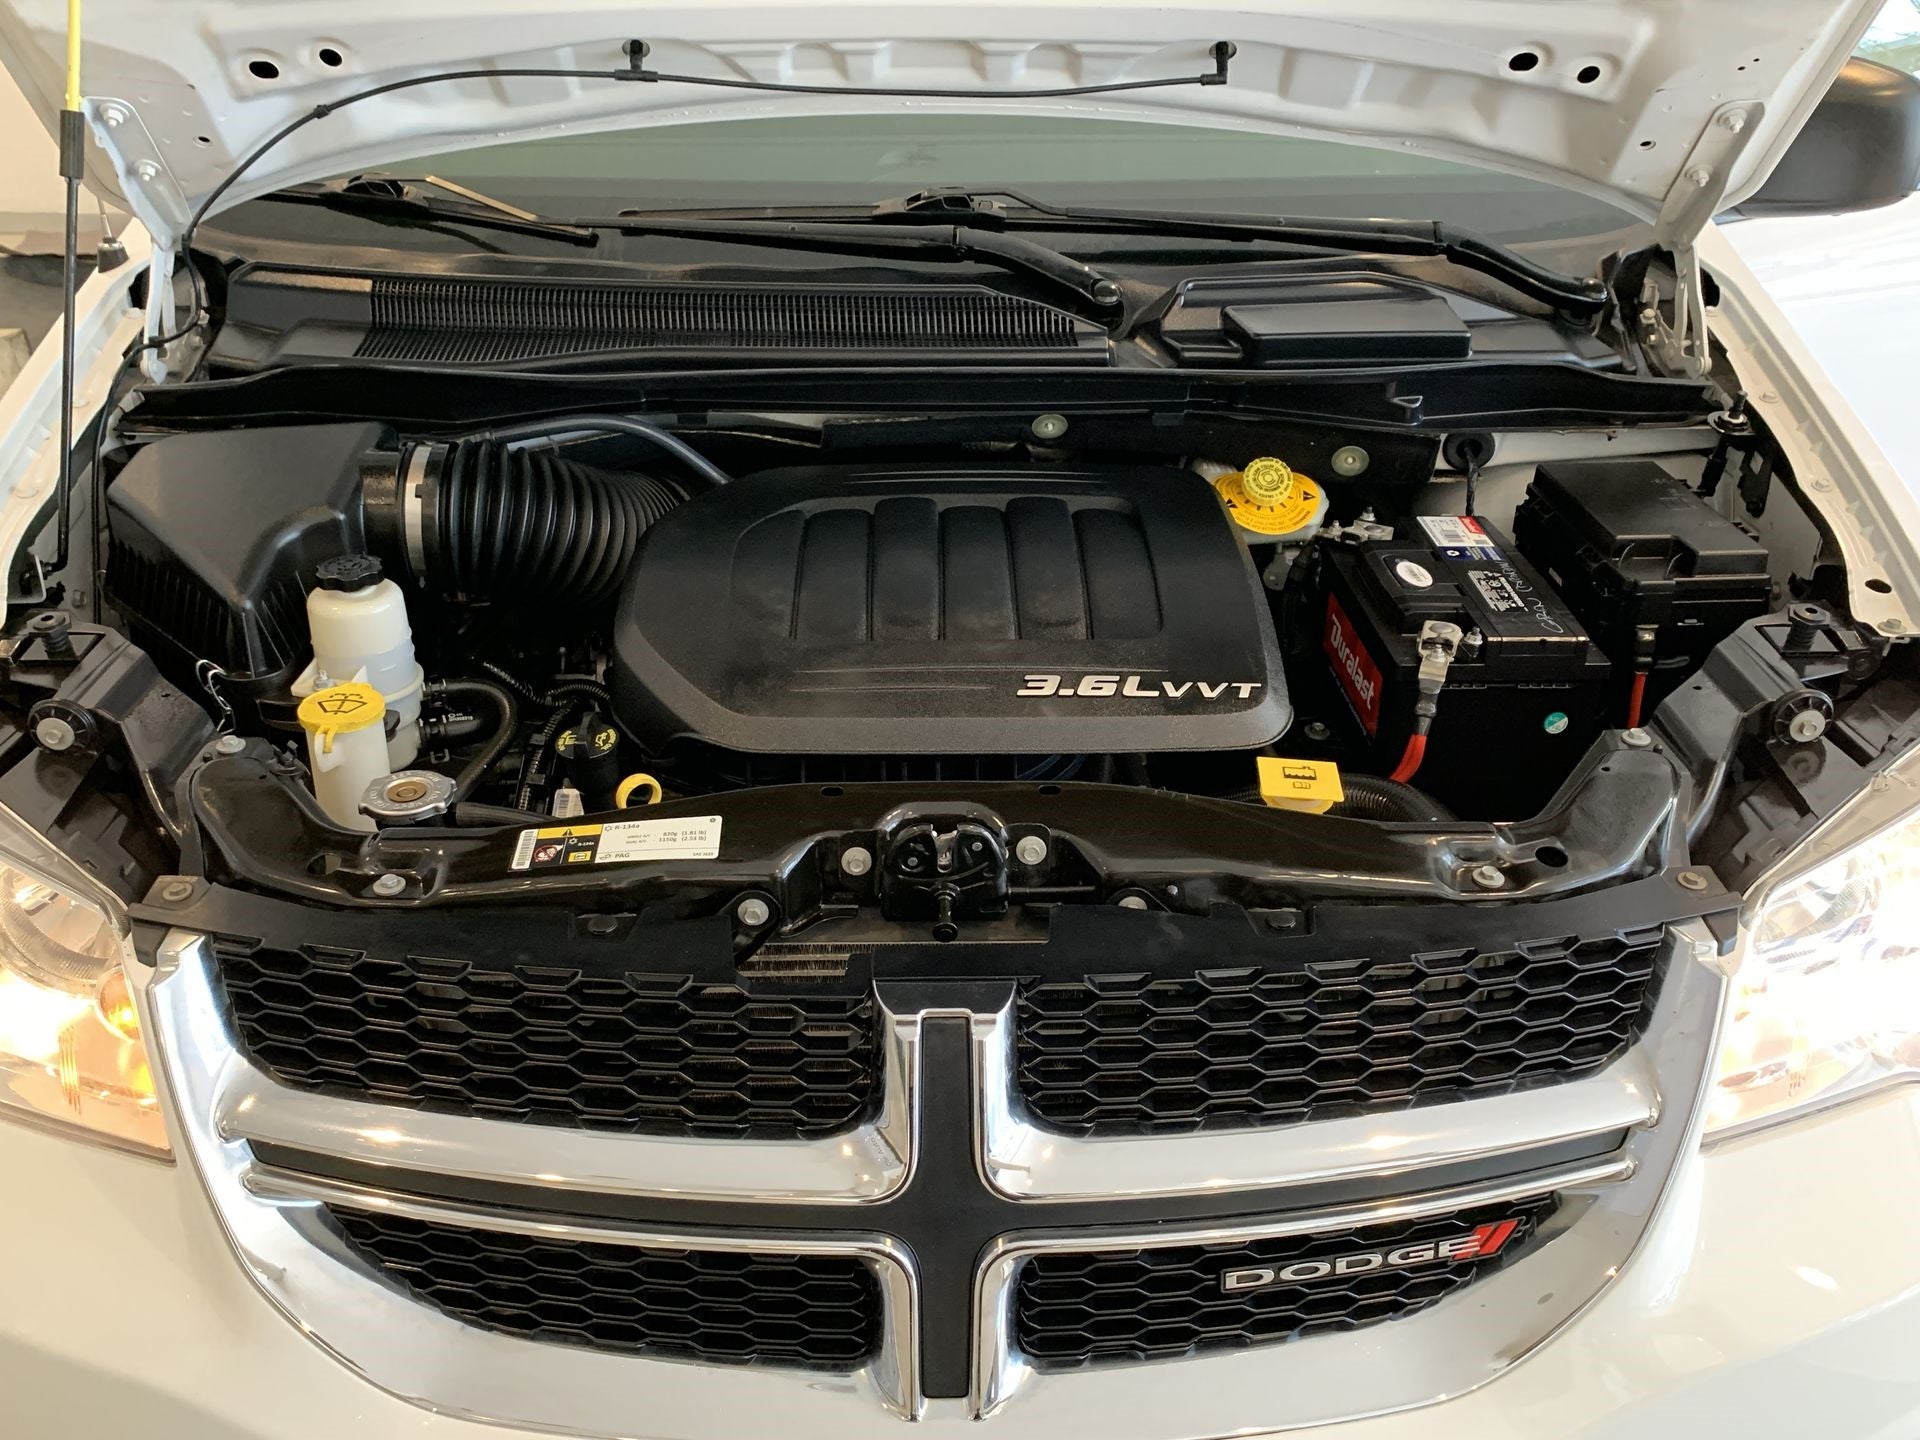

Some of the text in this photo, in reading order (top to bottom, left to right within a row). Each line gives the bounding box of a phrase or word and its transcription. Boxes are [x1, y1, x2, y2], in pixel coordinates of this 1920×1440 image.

[1330, 613, 1375, 711] Duralast
[1016, 674, 1262, 698] 3.6L VVT
[614, 851, 631, 859] PAG
[1224, 1233, 1482, 1290] DODGE
